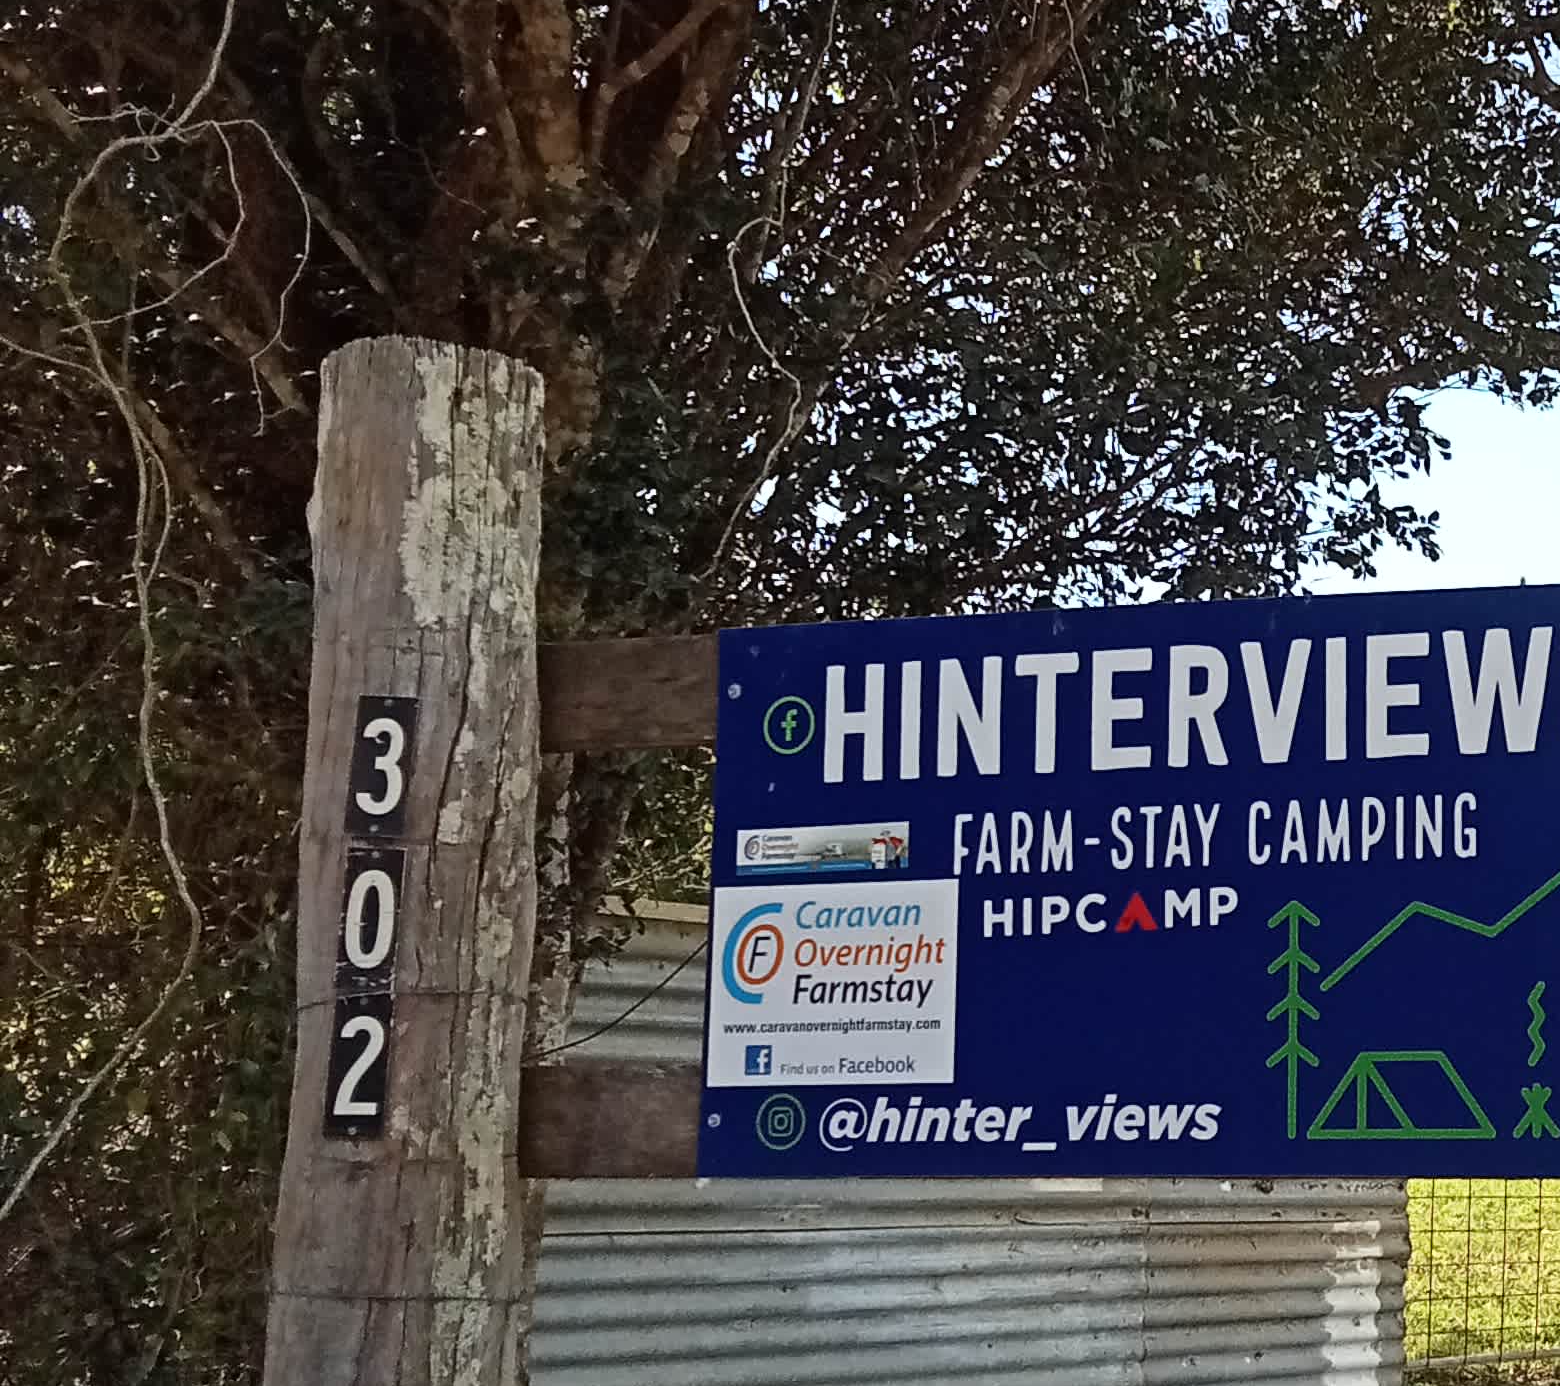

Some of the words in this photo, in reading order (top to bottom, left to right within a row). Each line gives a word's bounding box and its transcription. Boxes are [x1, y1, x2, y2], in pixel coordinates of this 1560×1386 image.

[952, 803, 1221, 876] FARM-STAY
[1247, 792, 1479, 867] CAMPING
[796, 901, 921, 930] Caravan
[983, 887, 1239, 937] HIPCAMP
[794, 934, 946, 974] Overnight
[792, 973, 935, 1008] Farmstay
[723, 1017, 942, 1035] www.caravanovernightfarmstay.com
[780, 1063, 804, 1076] Find
[806, 1065, 819, 1075] us
[821, 1065, 835, 1075] on
[838, 1056, 916, 1074] Facebook
[818, 1094, 1222, 1153] @hinter_views
